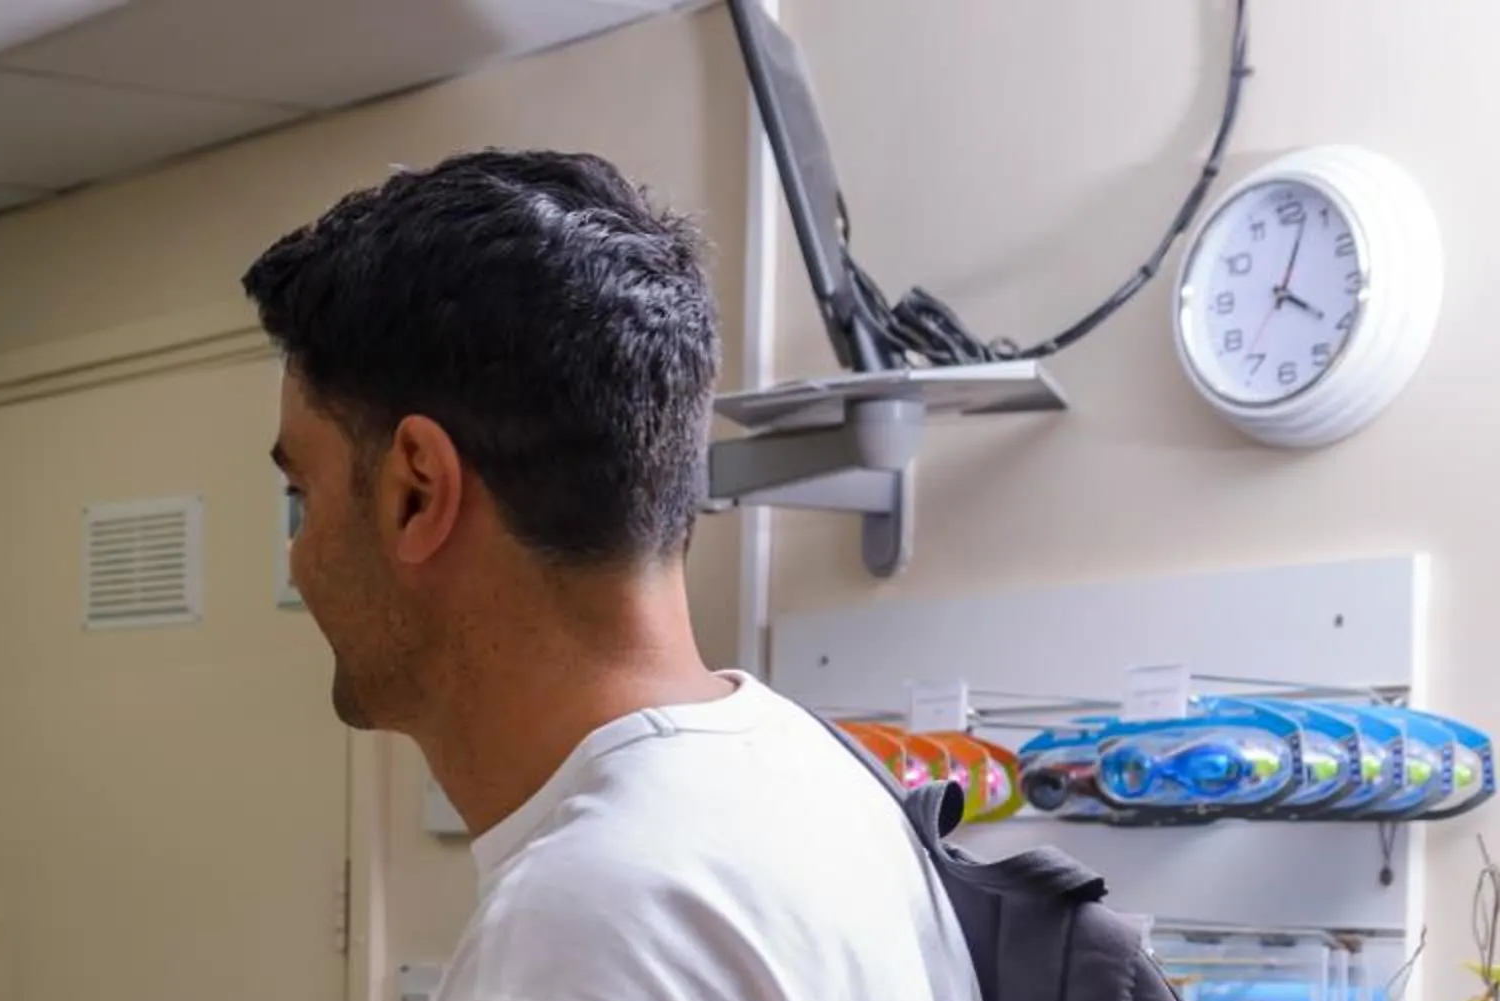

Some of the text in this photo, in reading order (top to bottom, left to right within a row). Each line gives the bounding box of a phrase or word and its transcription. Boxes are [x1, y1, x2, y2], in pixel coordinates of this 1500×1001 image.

[1276, 201, 1304, 226] 12
[1250, 221, 1266, 242] 11
[1334, 232, 1356, 258] 2
[1226, 253, 1252, 275] 10
[1344, 271, 1364, 295] 3
[1216, 292, 1235, 315] 9
[1335, 312, 1356, 331] 4
[1224, 328, 1243, 352] 8
[1244, 353, 1266, 375] 7
[1311, 342, 1332, 367] 5
[1277, 362, 1297, 384] 6
